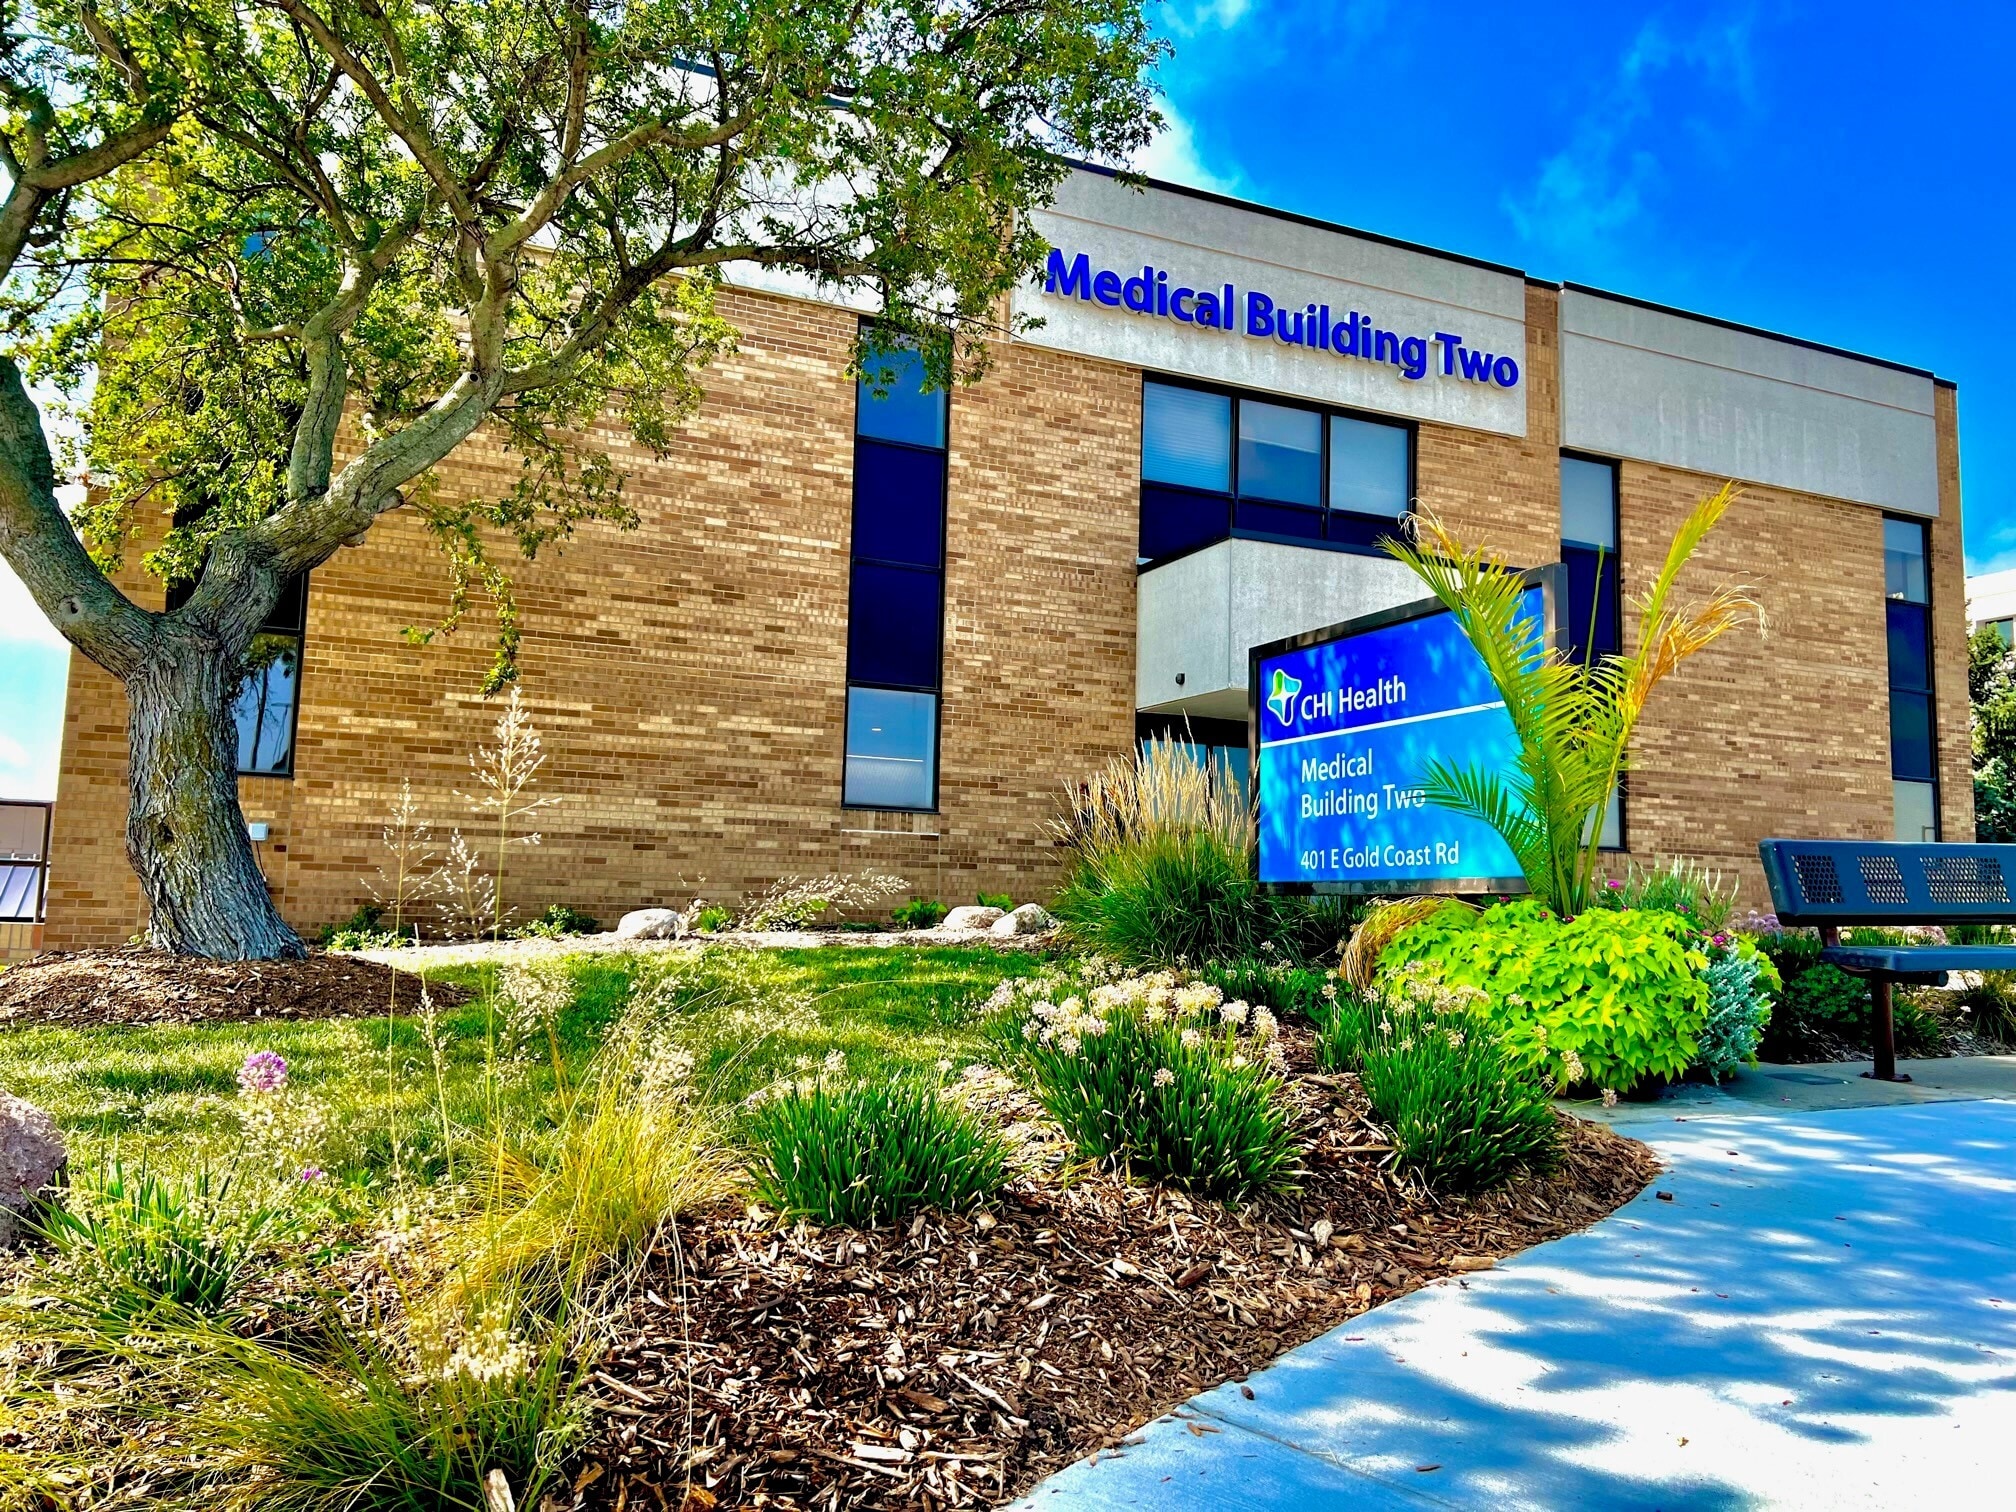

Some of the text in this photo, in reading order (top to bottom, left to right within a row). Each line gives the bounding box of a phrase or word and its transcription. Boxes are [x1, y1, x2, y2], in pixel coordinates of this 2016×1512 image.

[1045, 248, 1519, 388] Medical Building Two
[1301, 675, 1406, 721] CHI Health
[1301, 748, 1373, 783] Medical
[1301, 784, 1426, 820] Building Two
[1301, 841, 1459, 870] 401 E Gold Coast Rd
